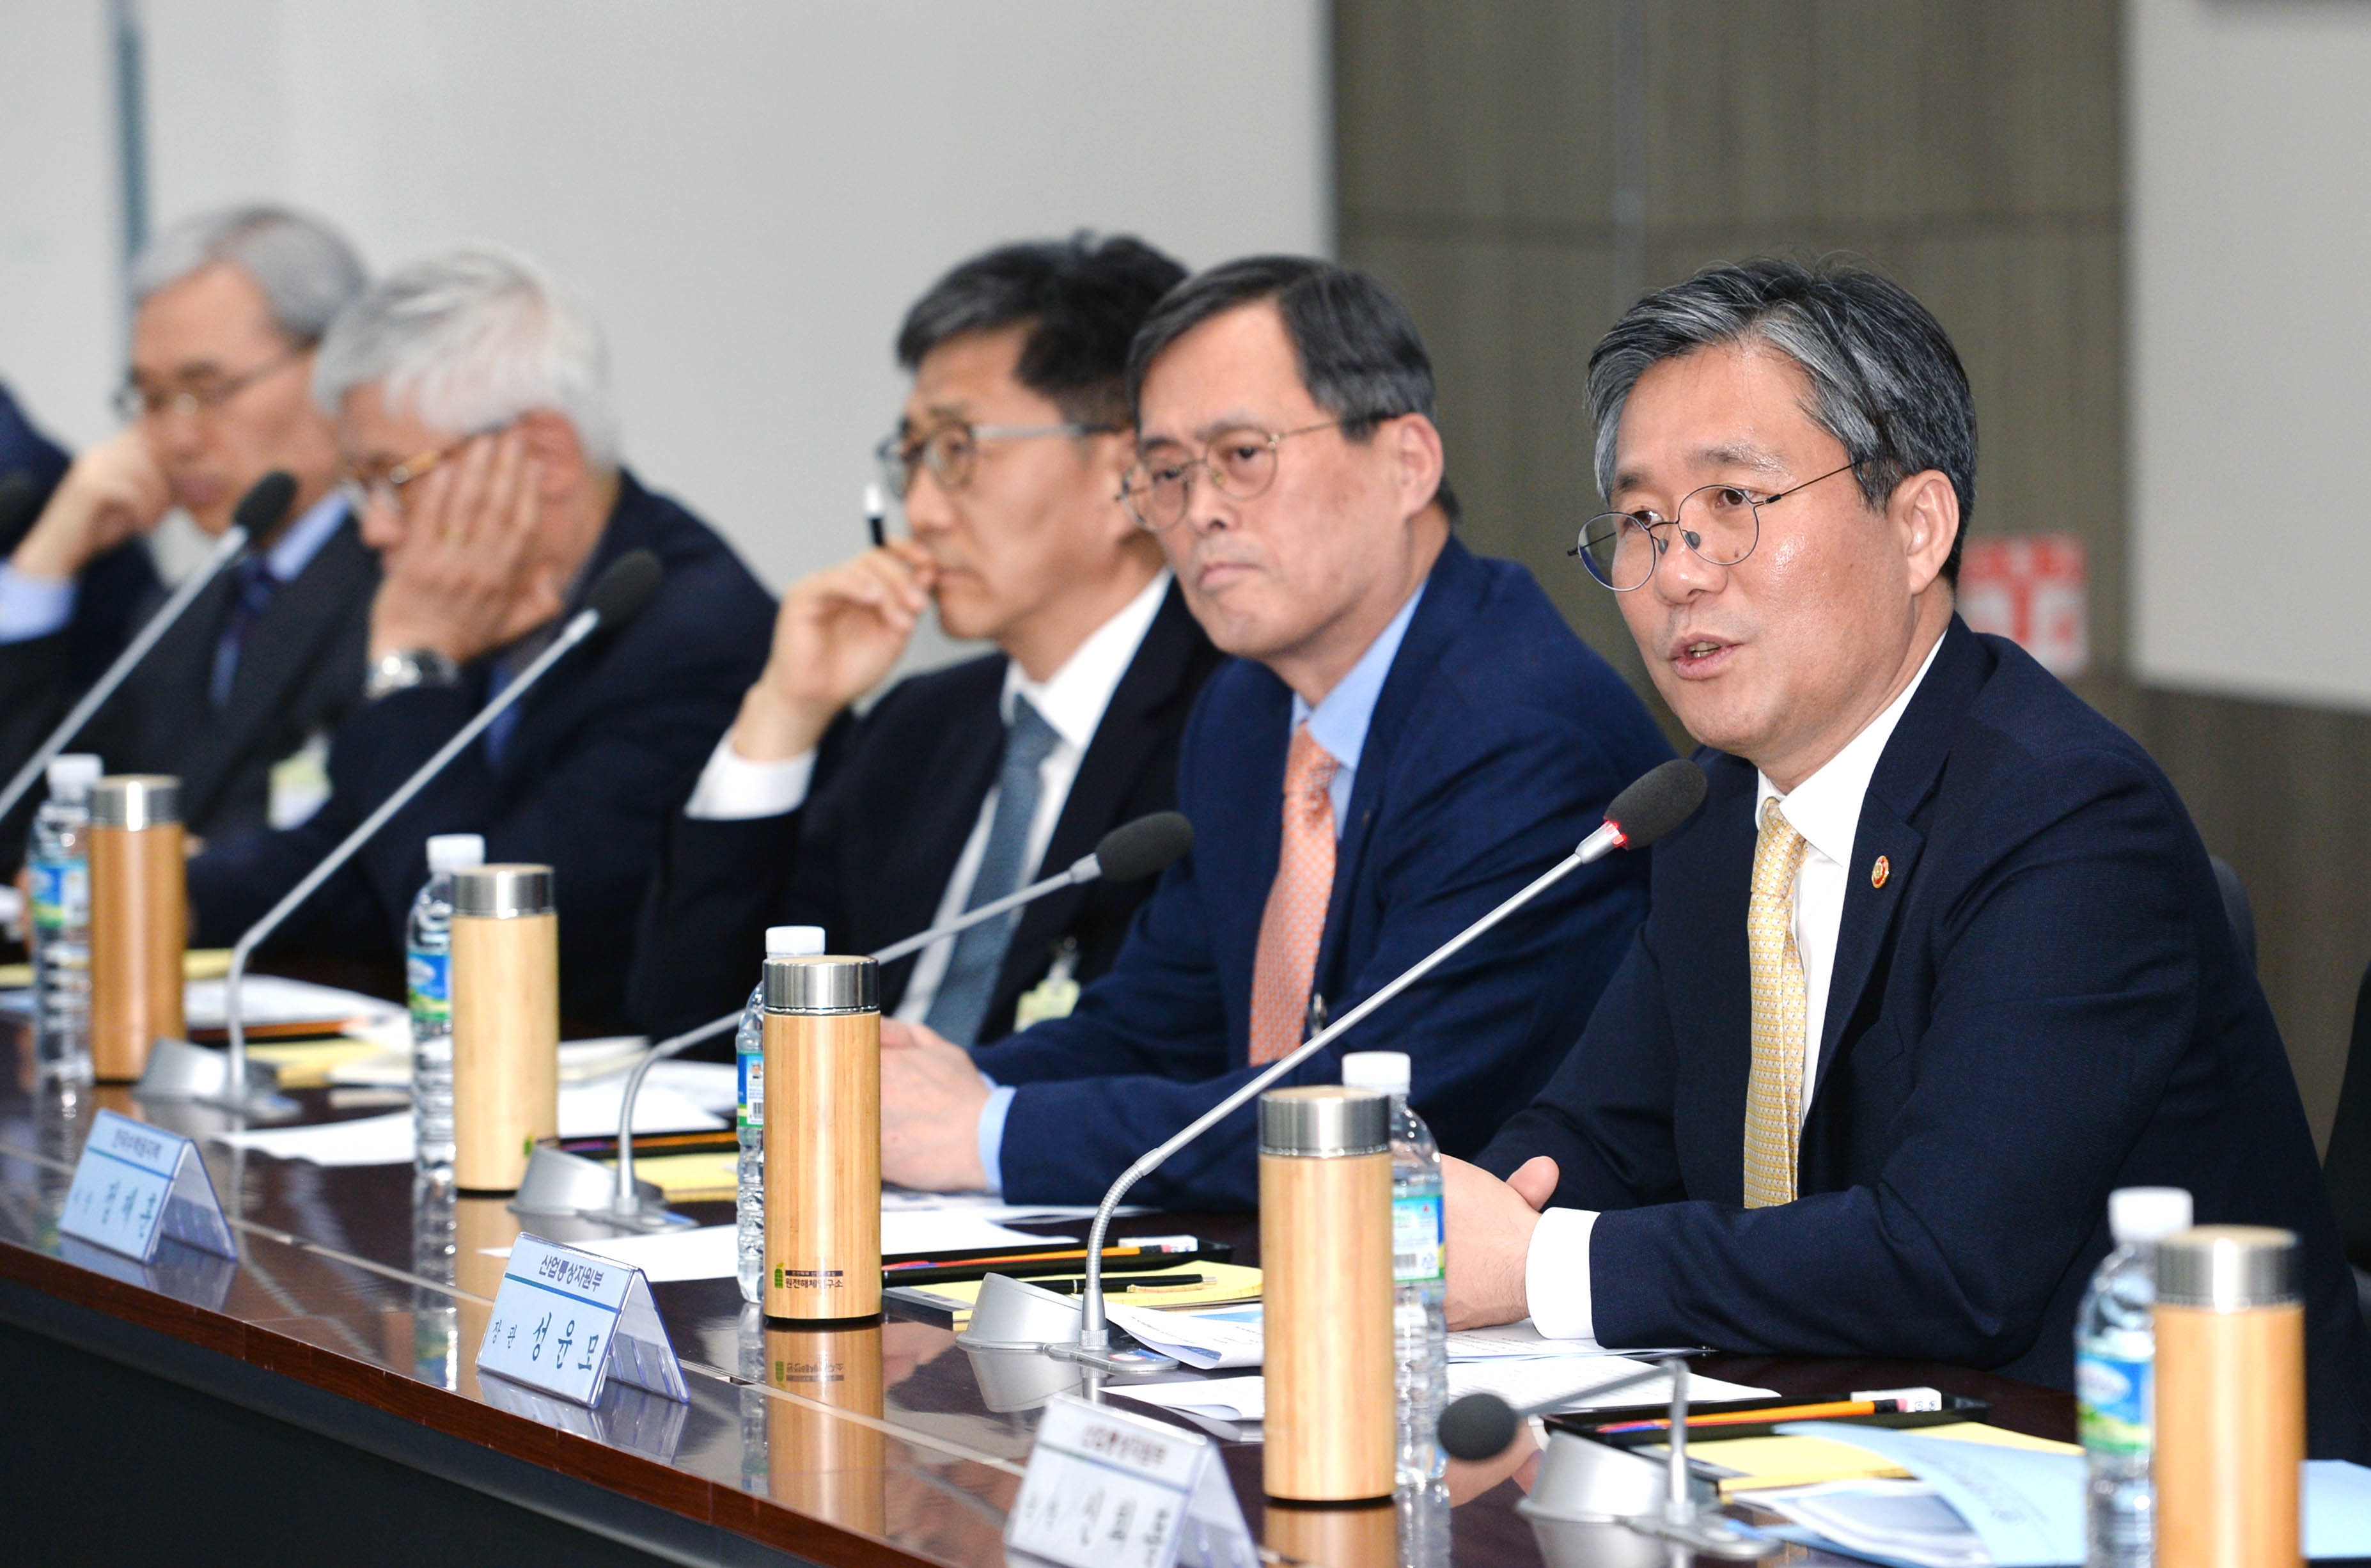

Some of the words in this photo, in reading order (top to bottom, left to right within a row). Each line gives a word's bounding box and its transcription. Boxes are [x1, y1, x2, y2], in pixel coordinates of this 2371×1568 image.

[538, 1254, 604, 1292] 산업통상자원부
[785, 1278, 843, 1289] 원전해체연구소
[531, 1312, 599, 1370] 성윤모
